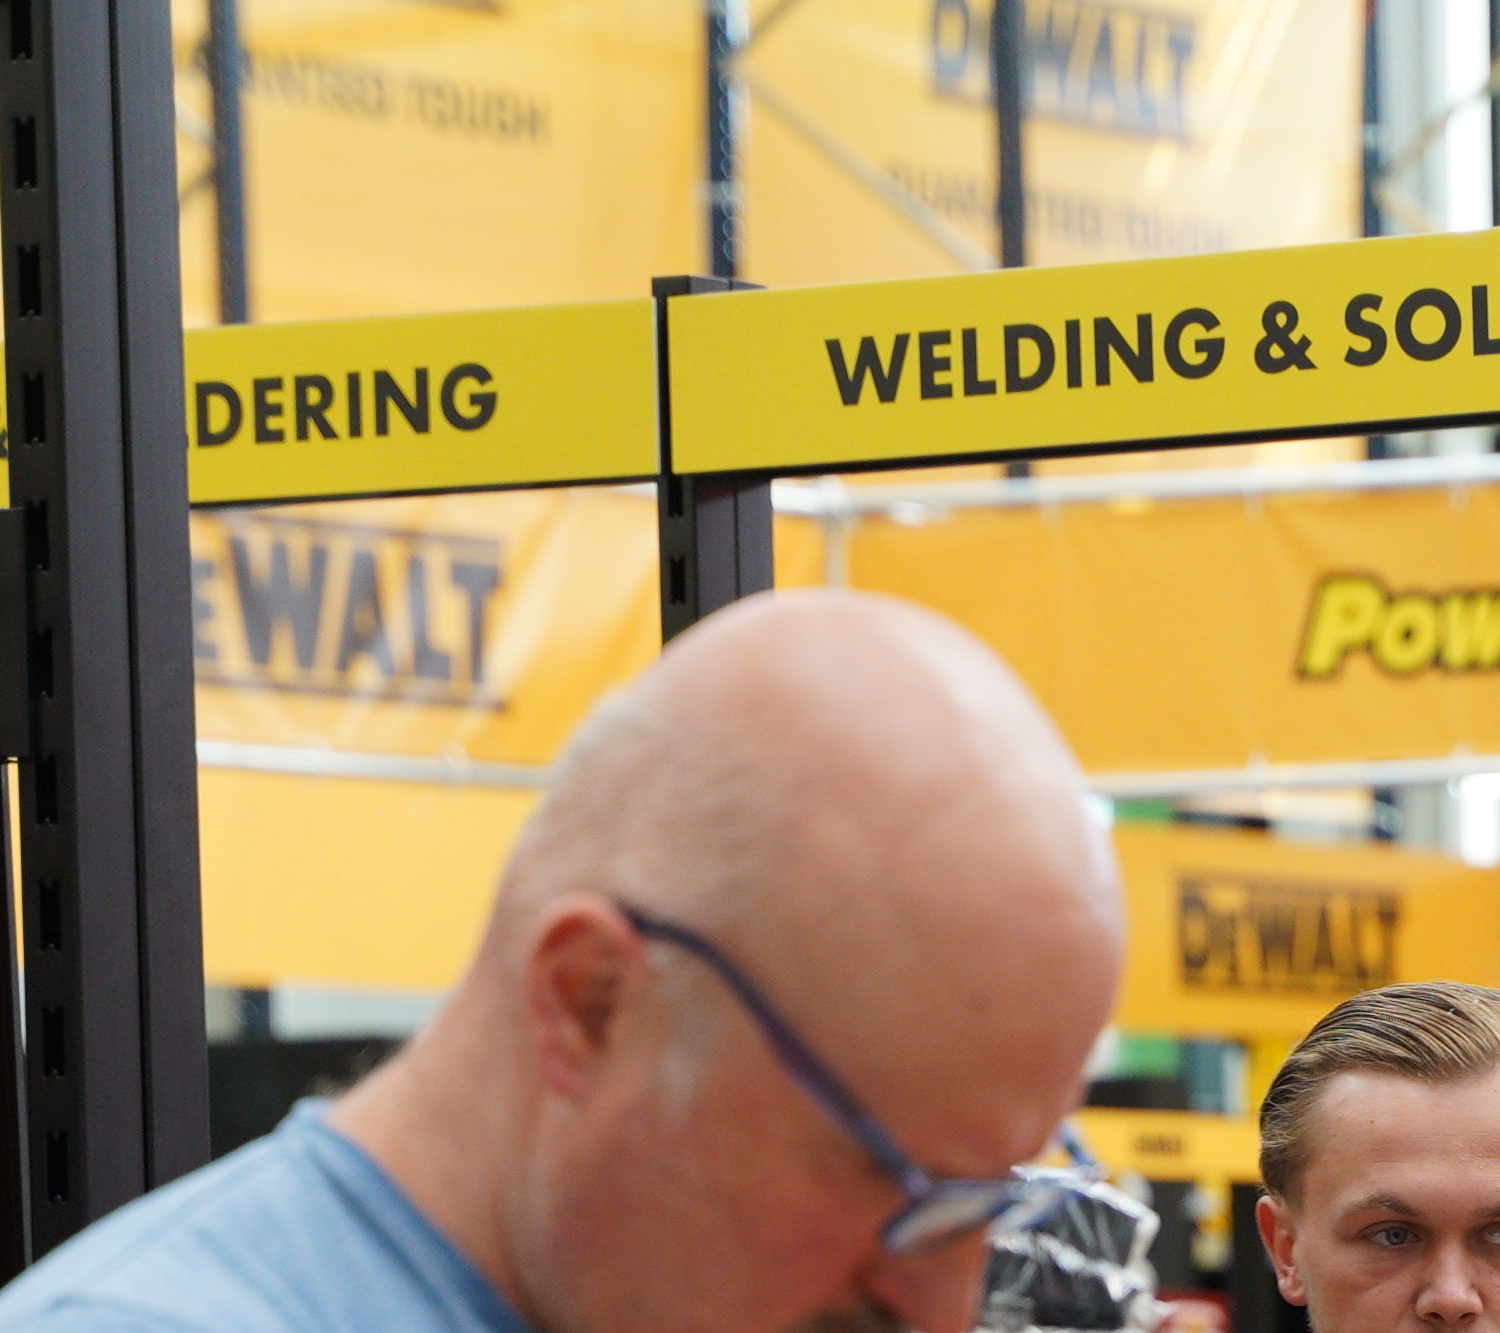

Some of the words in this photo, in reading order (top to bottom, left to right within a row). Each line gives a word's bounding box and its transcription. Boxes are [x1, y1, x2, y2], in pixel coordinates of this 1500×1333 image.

[826, 308, 1225, 406] WELDING
[1254, 302, 1317, 373] &
[193, 363, 498, 447] DERING
